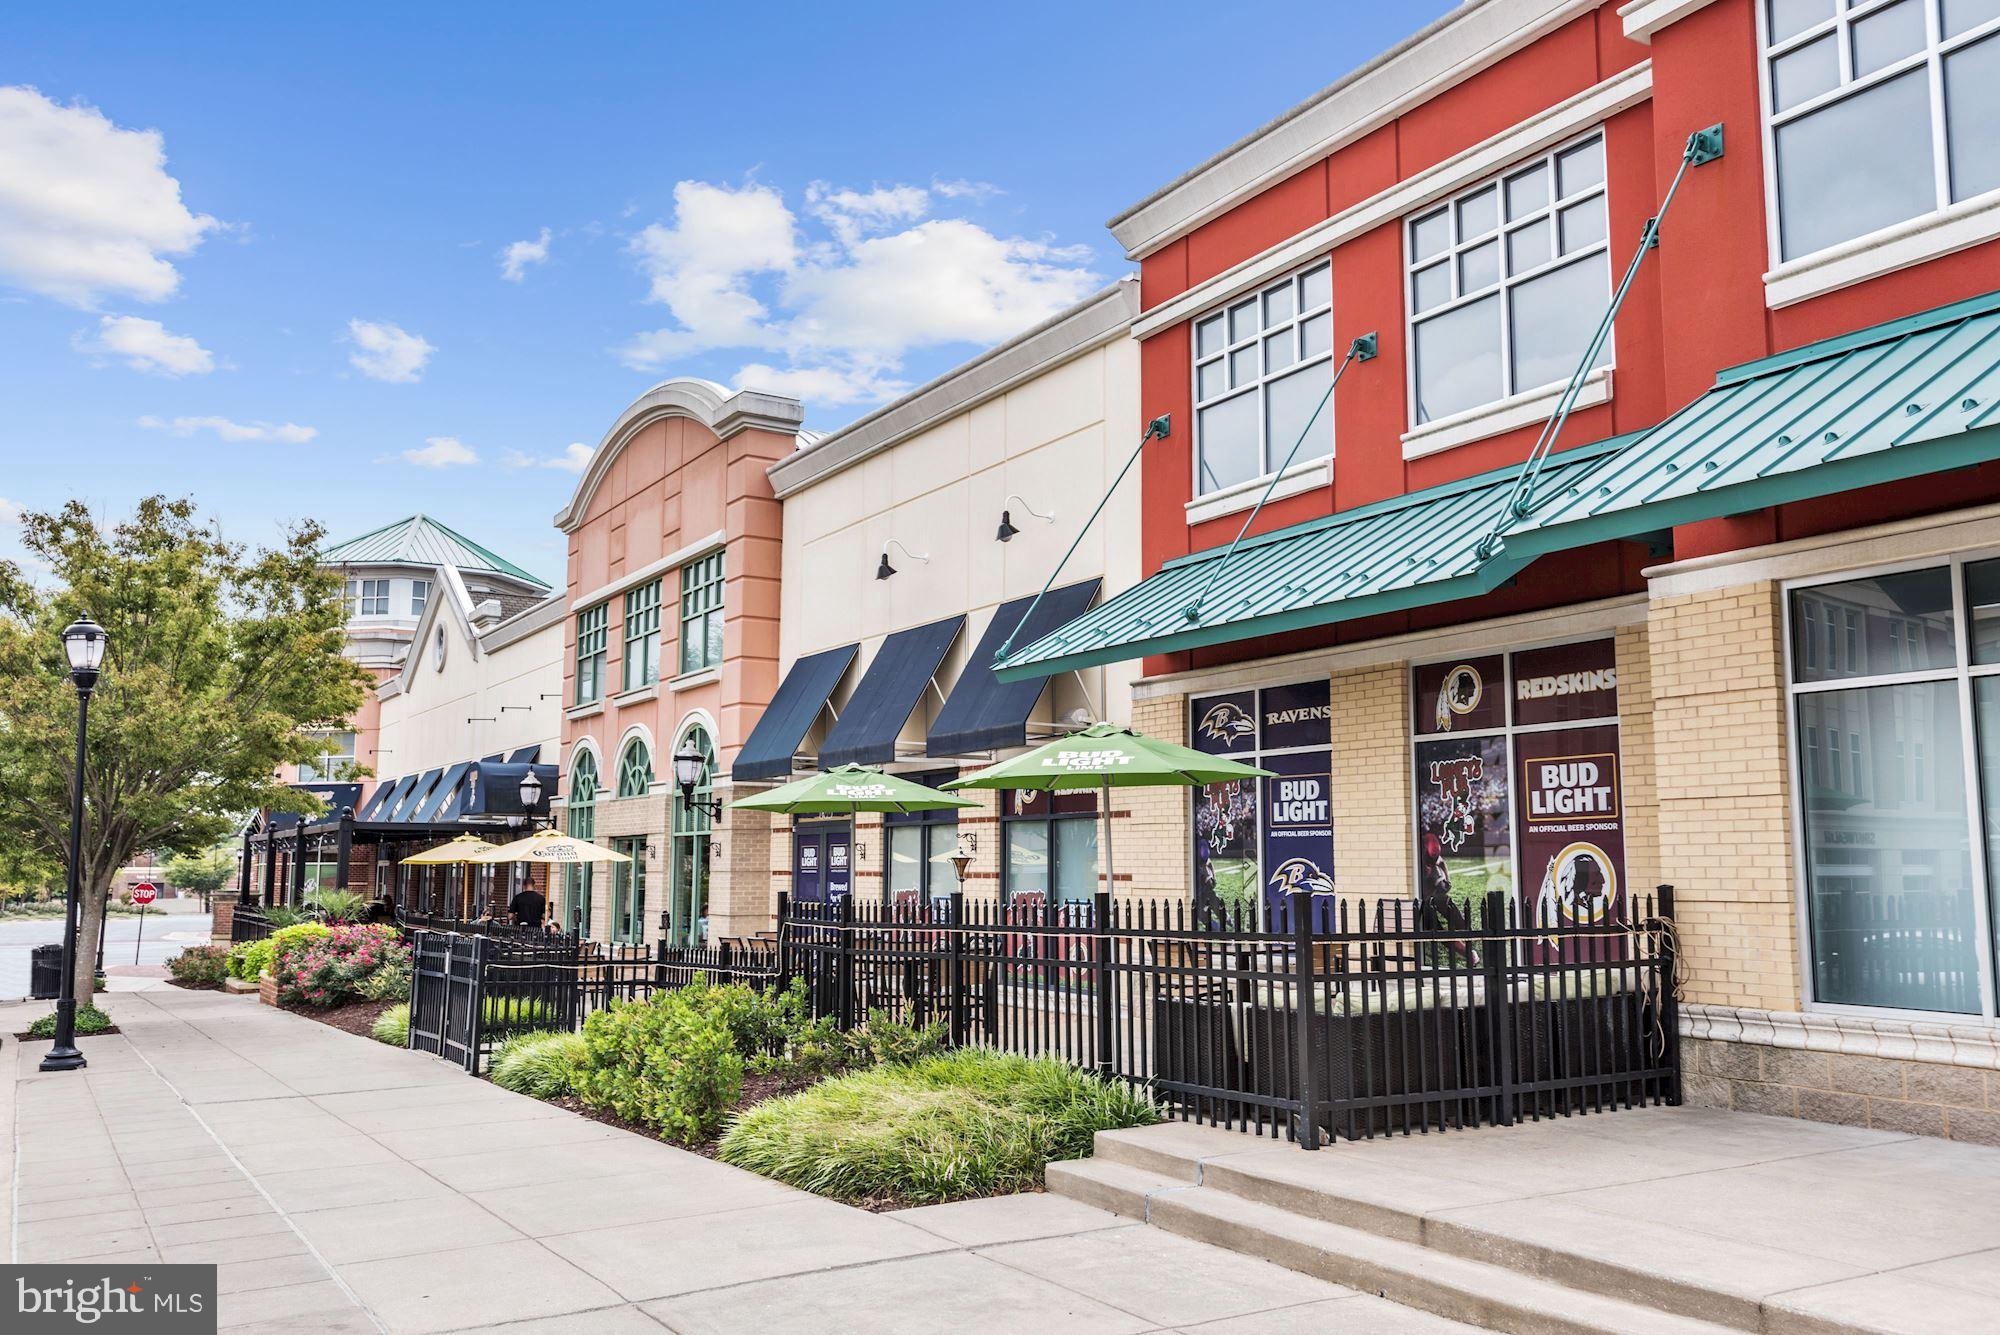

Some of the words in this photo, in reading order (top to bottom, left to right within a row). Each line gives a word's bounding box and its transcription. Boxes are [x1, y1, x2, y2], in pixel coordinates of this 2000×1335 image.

[1517, 668, 1616, 700] REDSKINS
[1266, 705, 1331, 726] RAVENS
[1057, 750, 1124, 758] BUD
[1041, 756, 1135, 767] LIGHT
[1541, 762, 1598, 789] BUD
[1280, 780, 1320, 802] BUD
[1531, 786, 1610, 814] LIGHT
[1273, 800, 1328, 822] LIGHT
[1539, 825, 1567, 833] OFFICIAL
[1567, 824, 1584, 832] BEER
[1585, 823, 1618, 831] SPONSOR
[804, 848, 816, 857] BUD
[833, 846, 846, 857] BUD
[801, 857, 818, 867] LIGHT
[831, 856, 848, 866] LIGHT
[830, 881, 848, 891] Brewed
[133, 889, 155, 899] STOP
